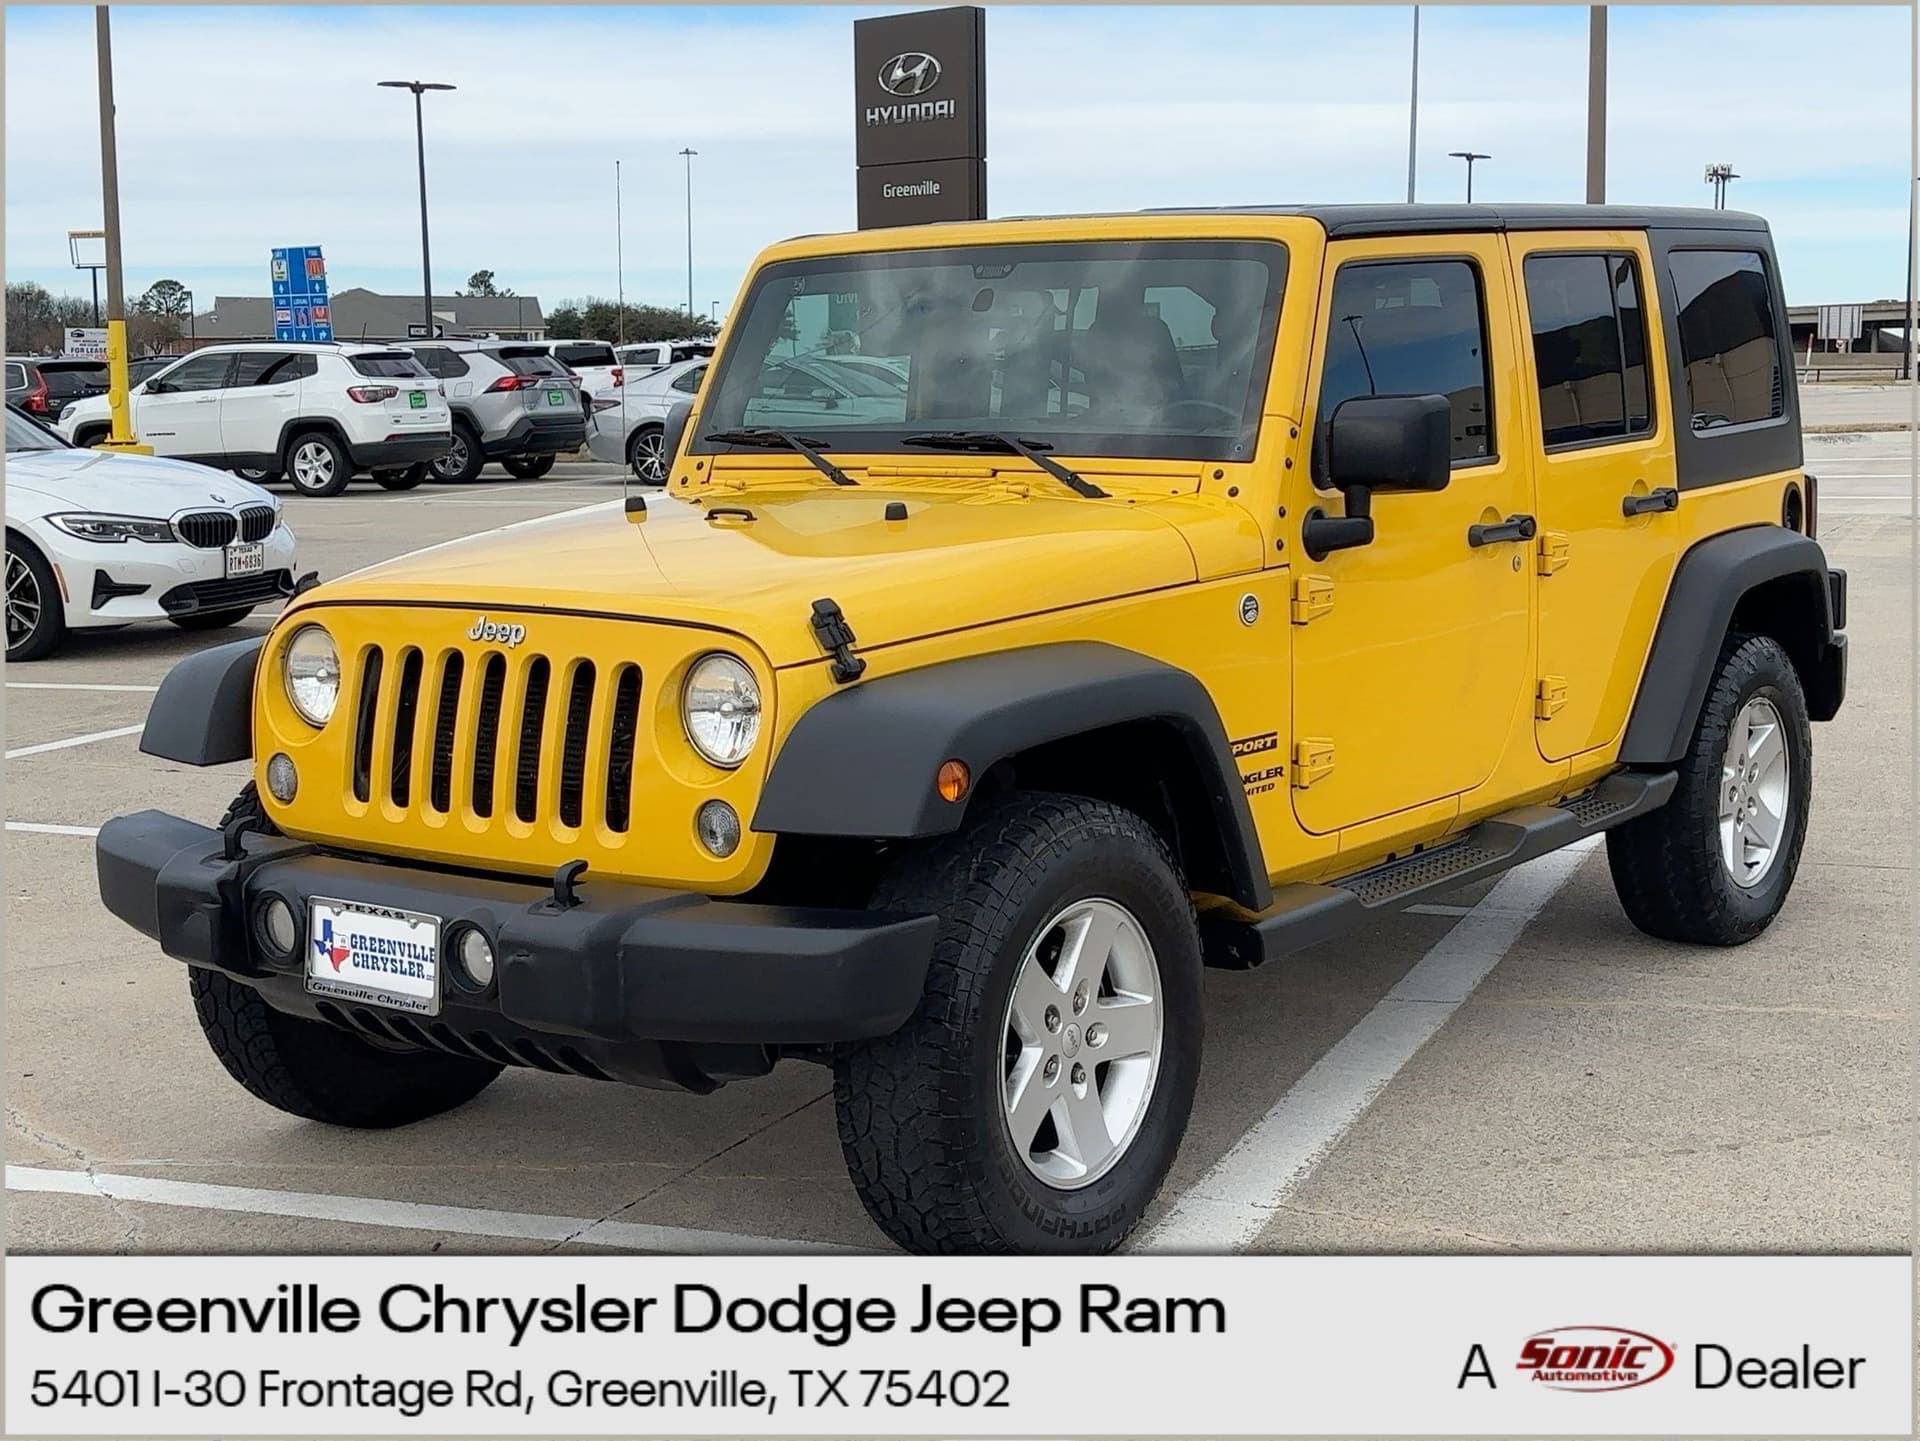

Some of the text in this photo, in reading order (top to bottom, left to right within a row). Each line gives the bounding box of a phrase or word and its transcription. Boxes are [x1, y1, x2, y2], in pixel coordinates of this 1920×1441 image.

[866, 100, 954, 125] HYUNDAI
[883, 181, 940, 198] Greenville
[468, 615, 527, 649] Jeep
[1231, 736, 1278, 755] PORT
[342, 903, 406, 920] TEXAS
[350, 933, 436, 963] GREENVILLE
[352, 951, 426, 979] CHRYSLER
[312, 981, 429, 1011] Greenville Chrysler
